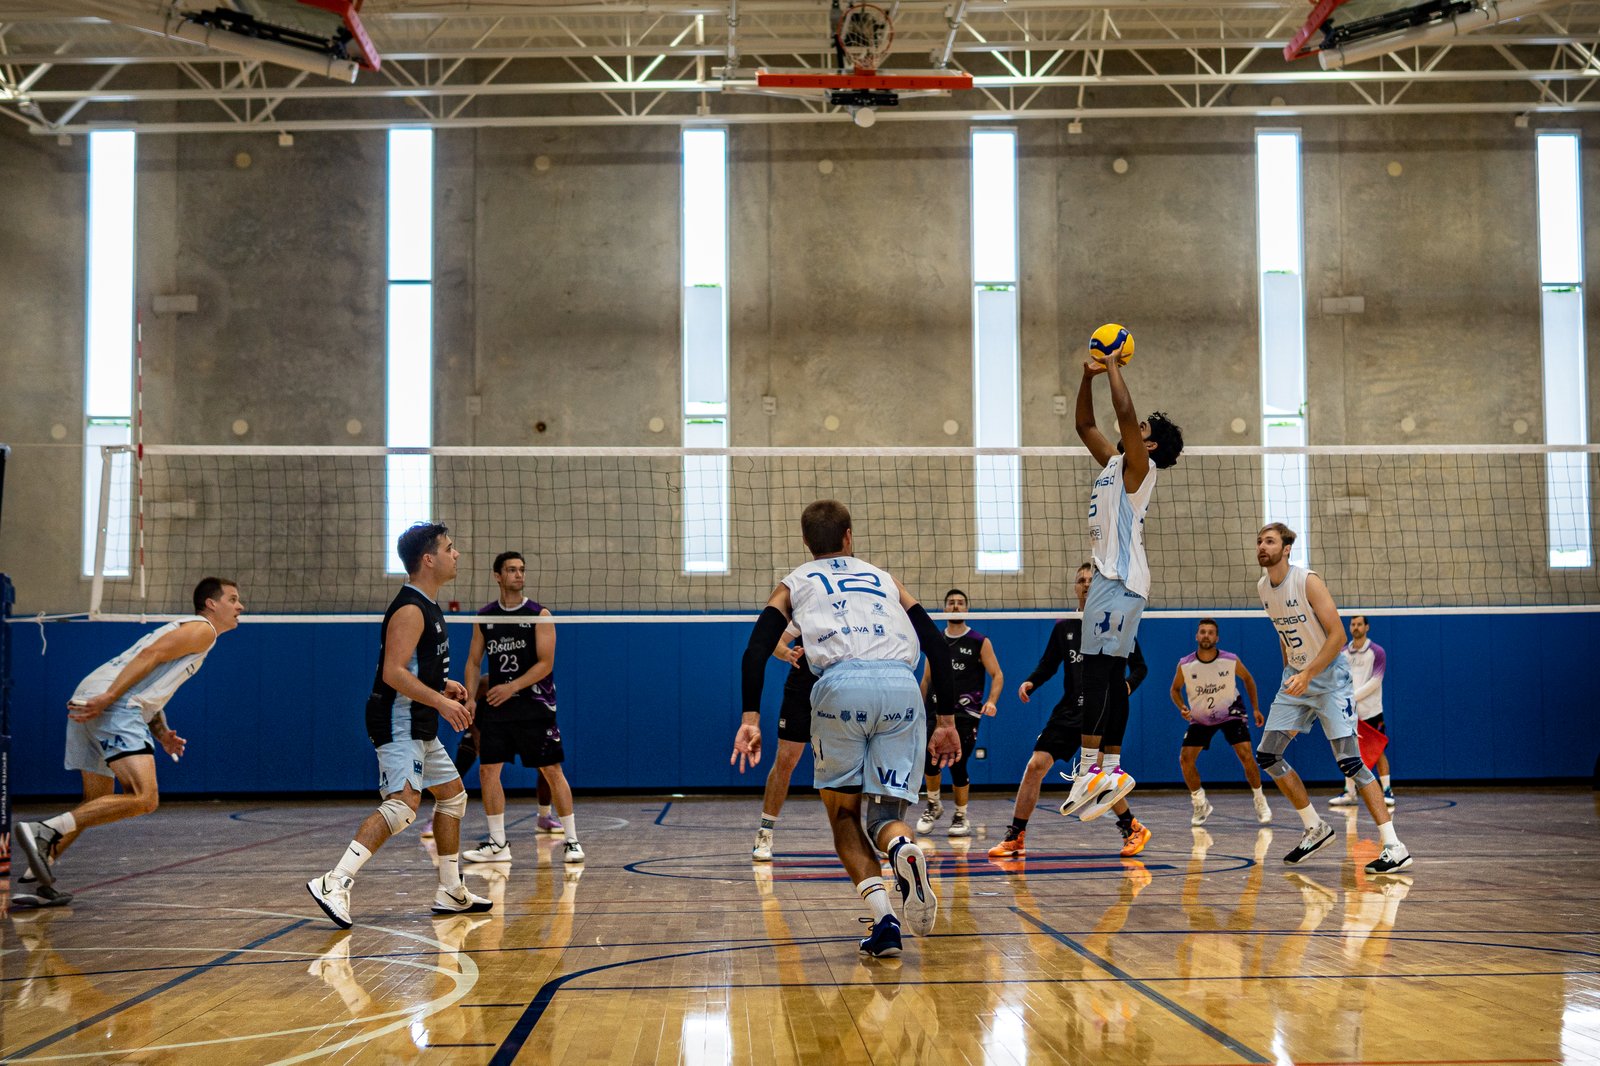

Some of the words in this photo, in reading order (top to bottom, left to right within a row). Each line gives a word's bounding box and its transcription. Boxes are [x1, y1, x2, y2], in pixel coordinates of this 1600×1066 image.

[807, 572, 887, 598] 12
[1273, 614, 1307, 626] HICAGO
[1279, 629, 1303, 649] 15
[960, 647, 972, 655] VLA
[499, 654, 519, 673] 23
[1207, 697, 1215, 709] 2
